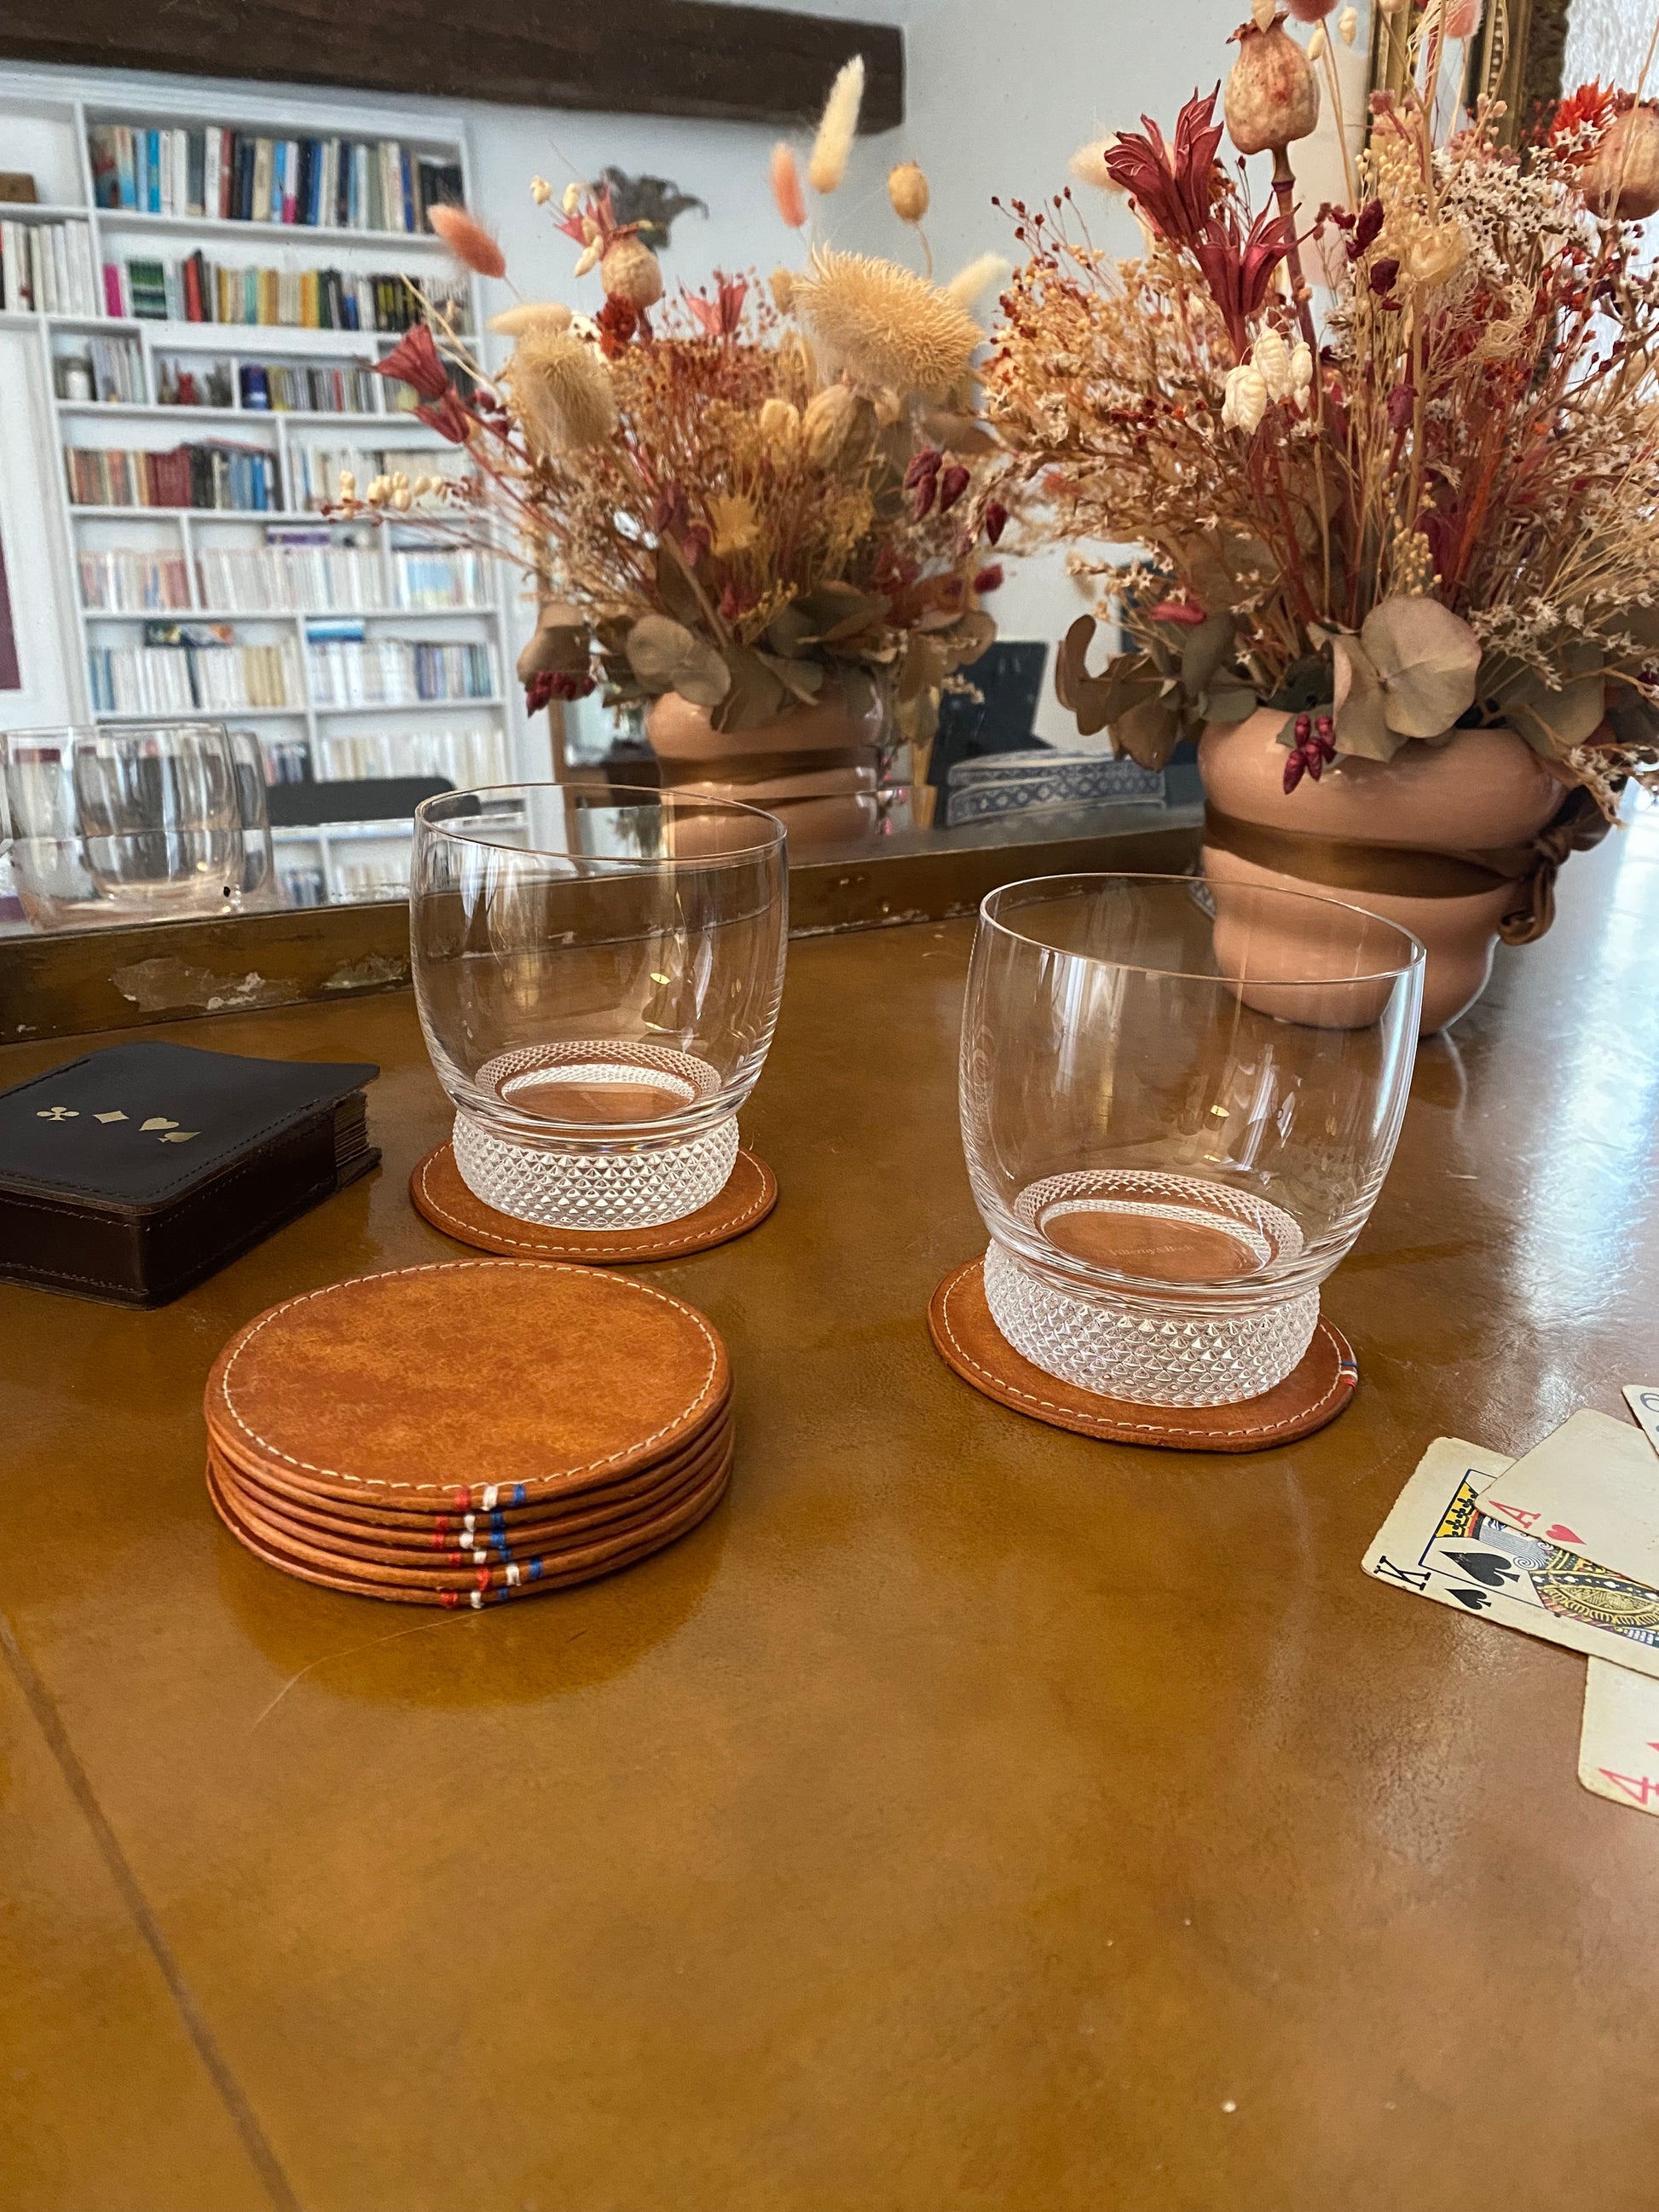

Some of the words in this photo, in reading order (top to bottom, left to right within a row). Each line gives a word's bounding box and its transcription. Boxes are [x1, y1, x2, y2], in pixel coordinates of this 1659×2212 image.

[1488, 1499, 1542, 1530] A
[1373, 1554, 1431, 1591] K
[1597, 1766, 1659, 1805] 4
